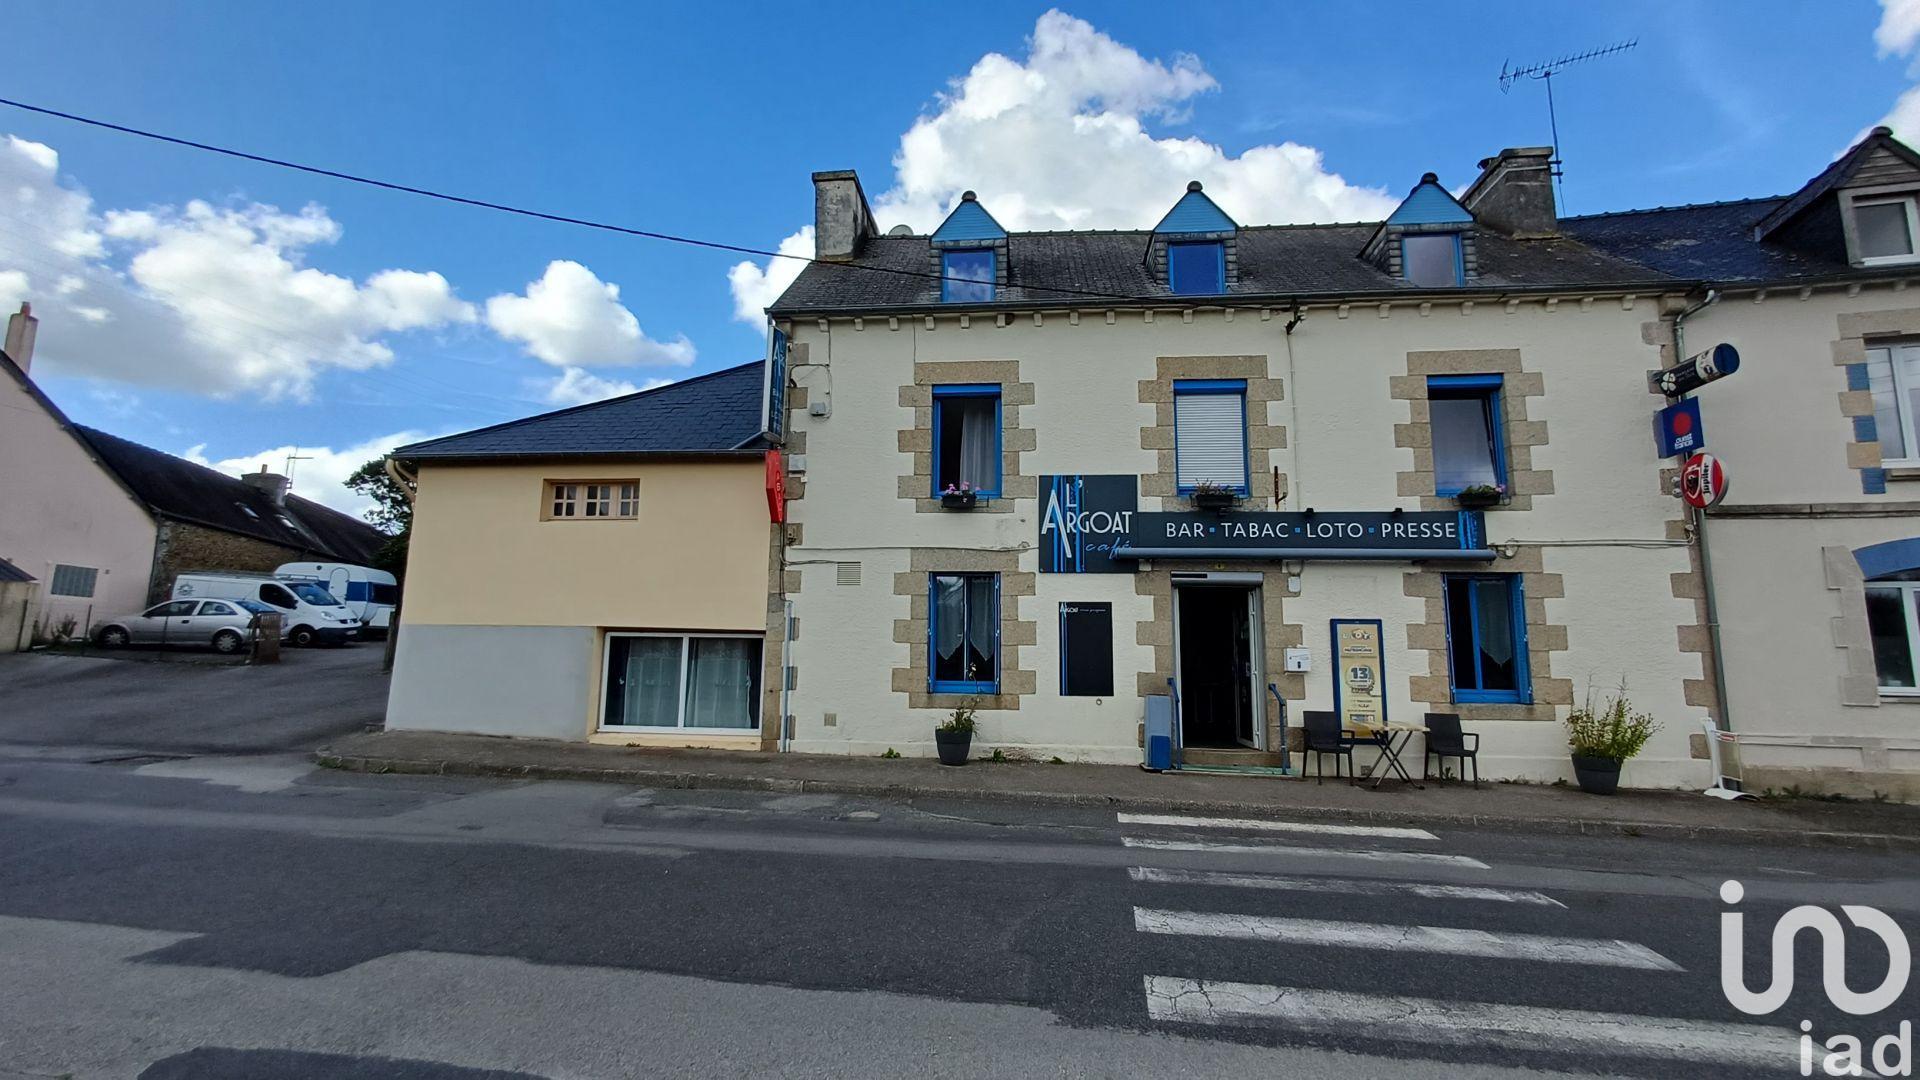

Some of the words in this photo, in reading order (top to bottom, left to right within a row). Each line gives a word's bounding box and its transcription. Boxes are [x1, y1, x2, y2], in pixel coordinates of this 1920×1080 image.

[1166, 522, 1205, 538] BAR
[1220, 522, 1289, 538] TABAC
[1306, 522, 1364, 538] LOTO
[1381, 522, 1456, 538] PRESSE
[1350, 667, 1368, 679] 13
